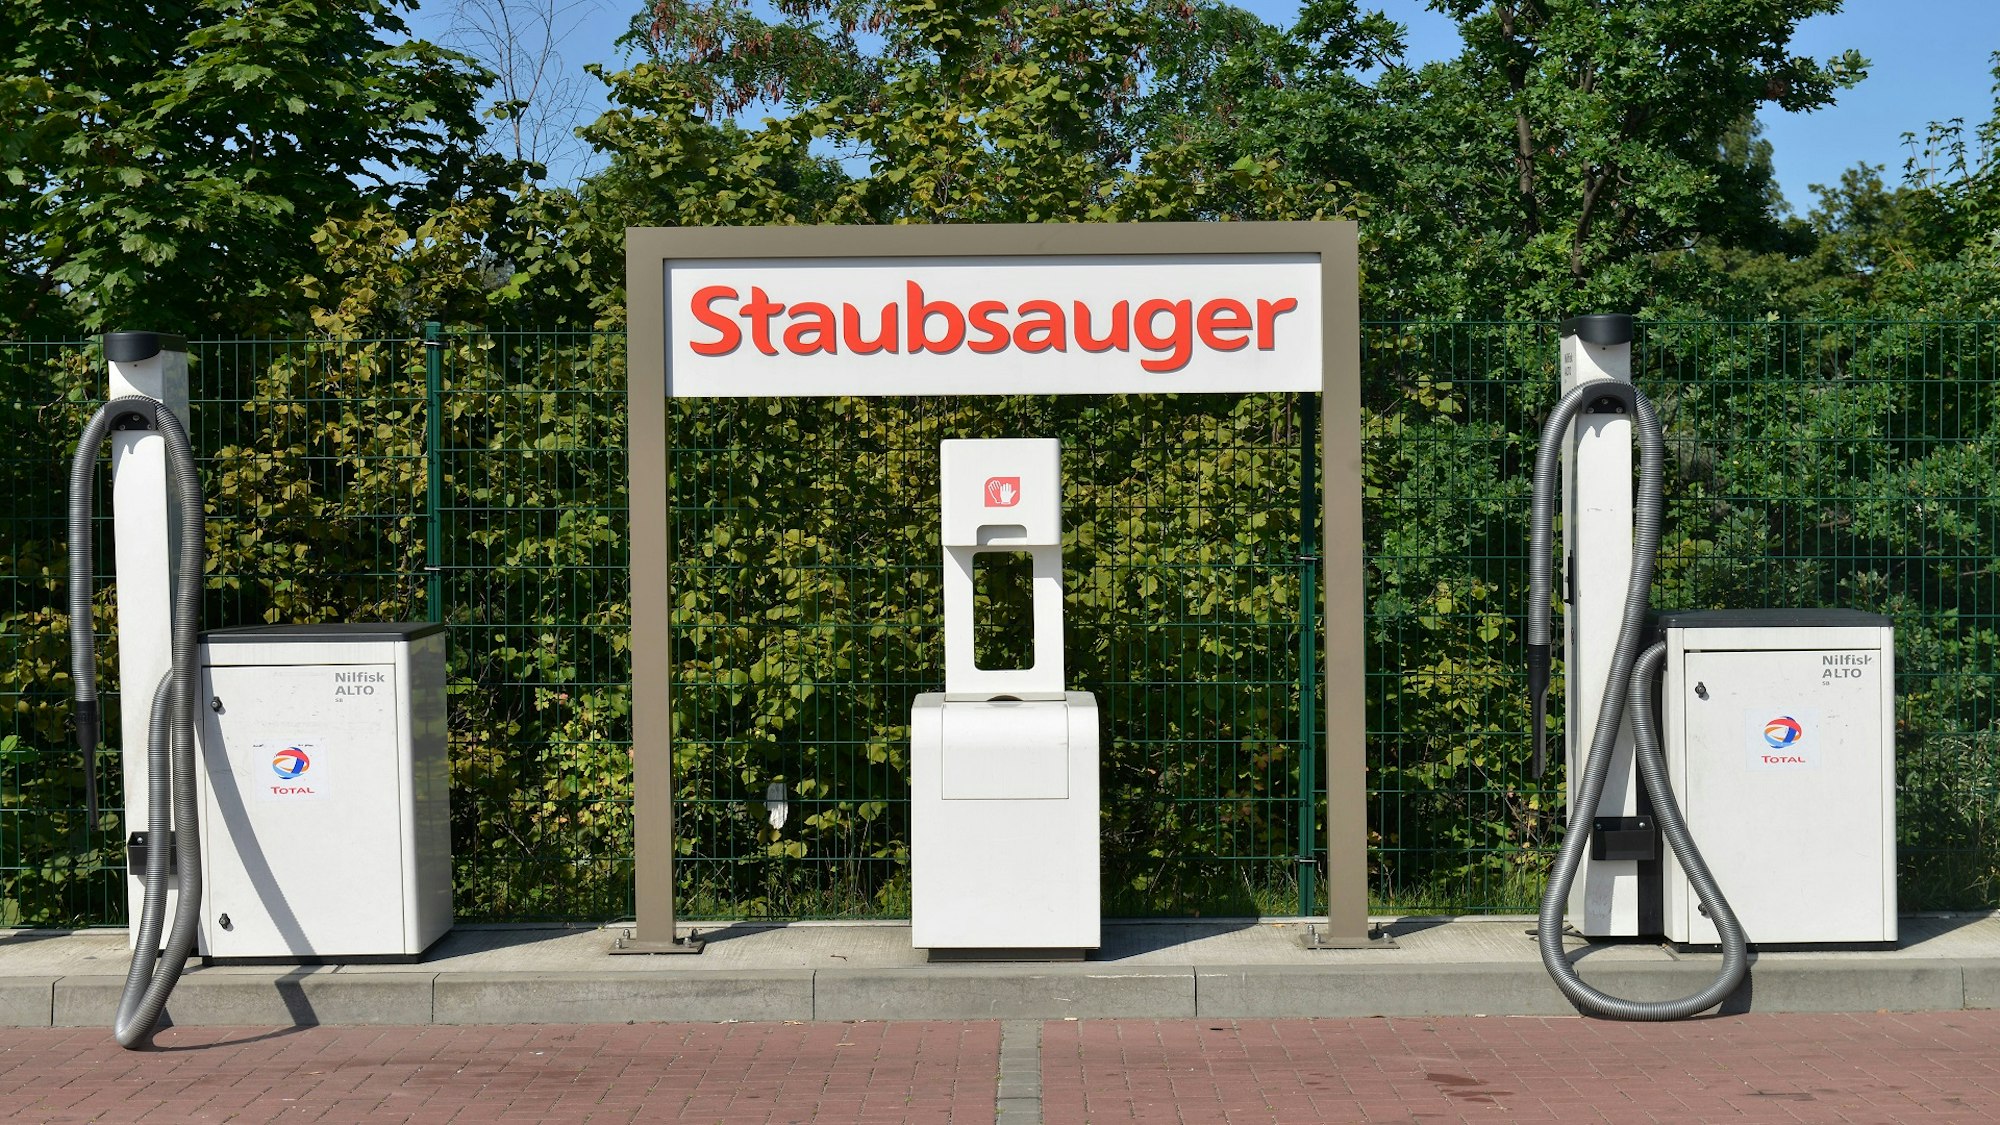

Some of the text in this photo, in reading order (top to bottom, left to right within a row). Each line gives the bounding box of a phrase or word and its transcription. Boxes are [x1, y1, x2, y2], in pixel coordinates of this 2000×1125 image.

[690, 280, 1298, 373] Staubsauger
[1822, 654, 1873, 665] Nilfisk
[335, 672, 385, 683] Nilfisk
[1822, 668, 1862, 679] ALTO
[335, 685, 375, 696] ALTO
[1761, 755, 1806, 764] TOTAL
[270, 786, 316, 795] TOTAL
